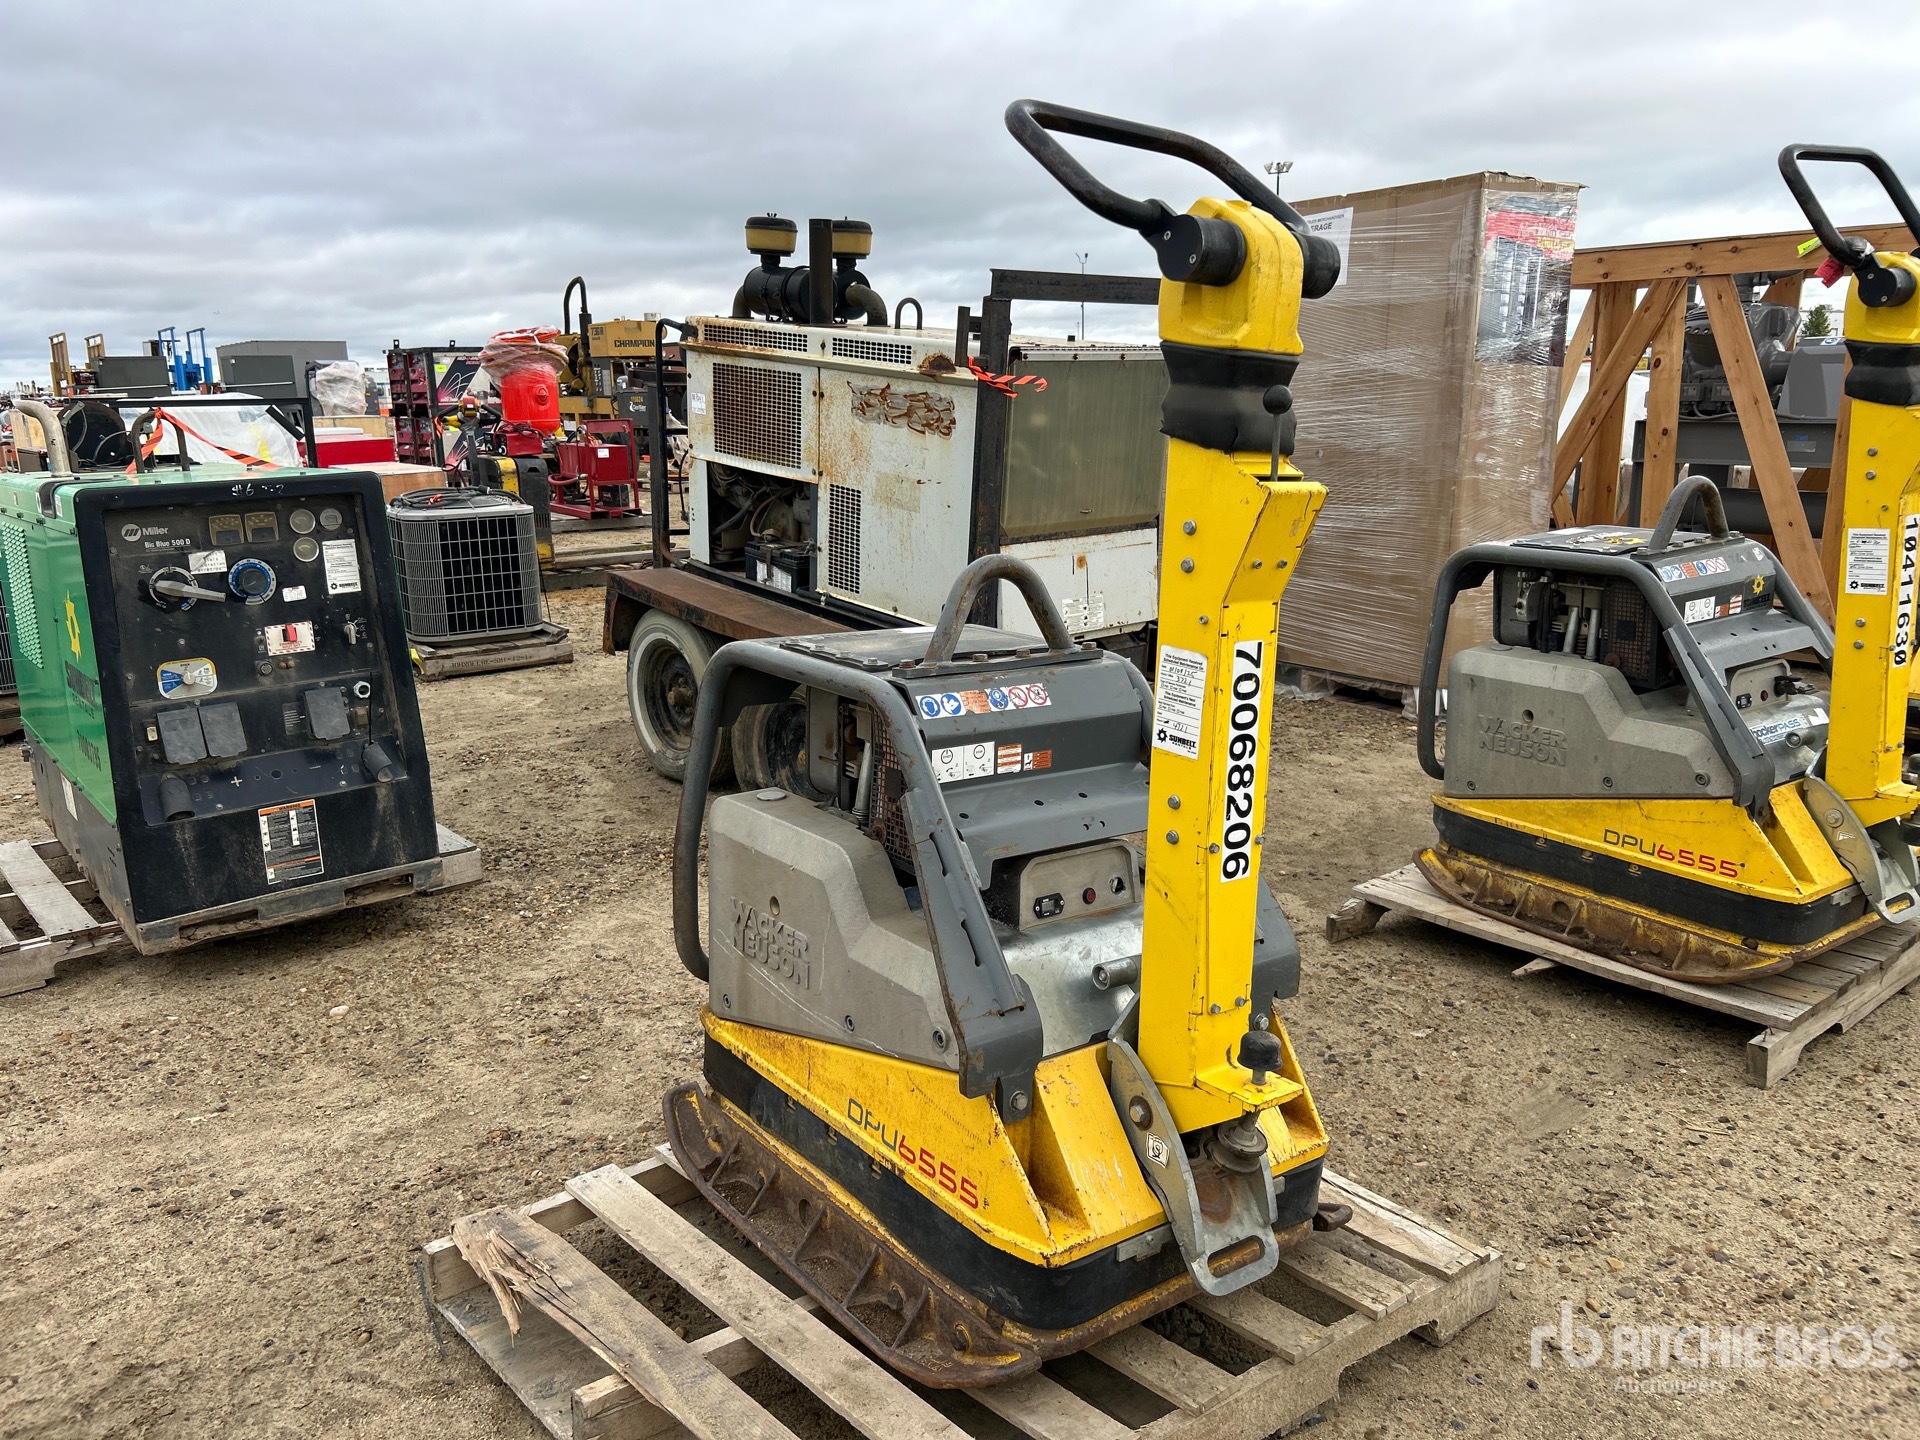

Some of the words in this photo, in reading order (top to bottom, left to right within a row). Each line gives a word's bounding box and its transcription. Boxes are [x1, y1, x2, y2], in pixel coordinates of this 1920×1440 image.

[614, 339, 656, 348] CHAMPION
[142, 526, 169, 536] Miller
[144, 541, 155, 549] Big
[155, 540, 170, 548] Blue
[171, 538, 185, 546] 500
[1180, 661, 1197, 669] Maintenance
[1168, 734, 1196, 748] SUNBELT
[1479, 714, 1567, 750] WACKER
[1480, 731, 1566, 767] NEUSON
[1222, 642, 1263, 880] 70068206
[1603, 828, 1740, 878] DPU6555
[729, 896, 809, 963] WACKER
[732, 924, 810, 990] NEUSON
[847, 1097, 980, 1211] DPU6555
